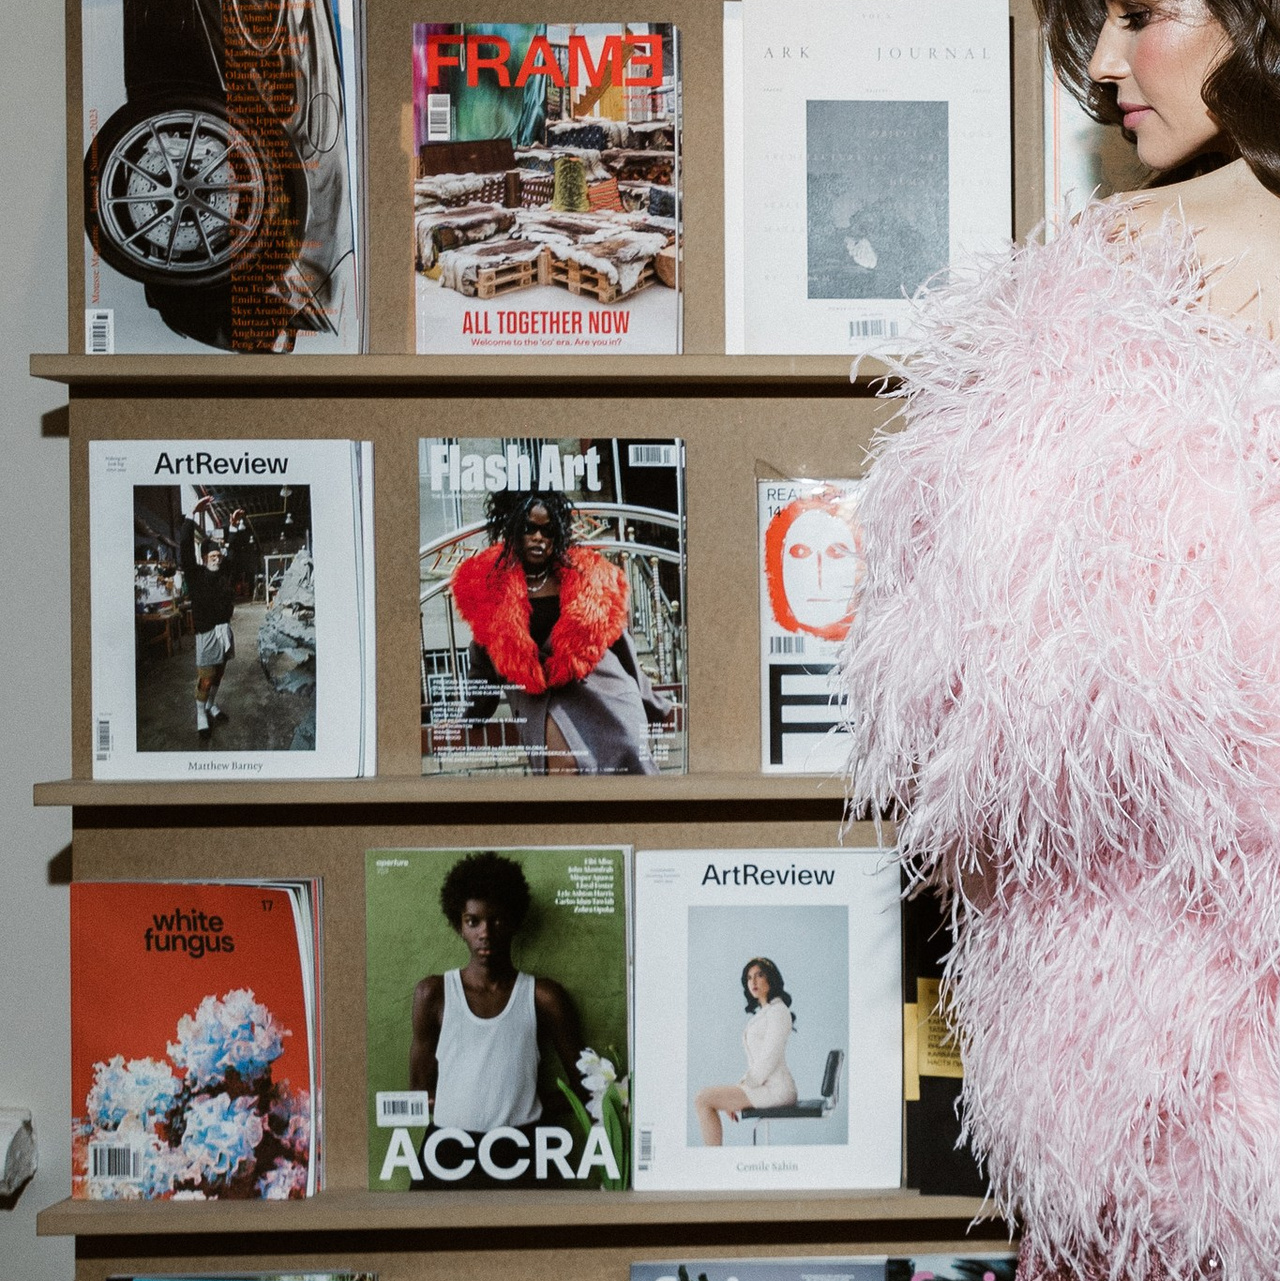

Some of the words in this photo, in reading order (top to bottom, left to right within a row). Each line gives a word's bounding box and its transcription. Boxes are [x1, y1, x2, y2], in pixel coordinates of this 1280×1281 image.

[763, 46, 811, 59] ARK
[876, 47, 992, 61] JOURNAL
[462, 310, 492, 334] ALL
[497, 310, 583, 334] TOGETHER
[588, 310, 631, 334] NOW
[471, 338, 512, 346] Welcome
[513, 338, 523, 346] to
[524, 338, 538, 346] the
[574, 338, 590, 346] Are
[609, 338, 622, 346] in?
[154, 451, 289, 475] ArtReview
[430, 444, 532, 492] Flash
[538, 444, 602, 492] Art
[188, 761, 230, 771] Matthew
[231, 761, 264, 773] Barney
[701, 863, 836, 886] ArtReview
[260, 899, 275, 912] 17
[151, 907, 224, 933] white
[144, 927, 236, 959] fungus
[379, 1126, 621, 1181] ACCRA
[736, 1161, 770, 1172] Cemile
